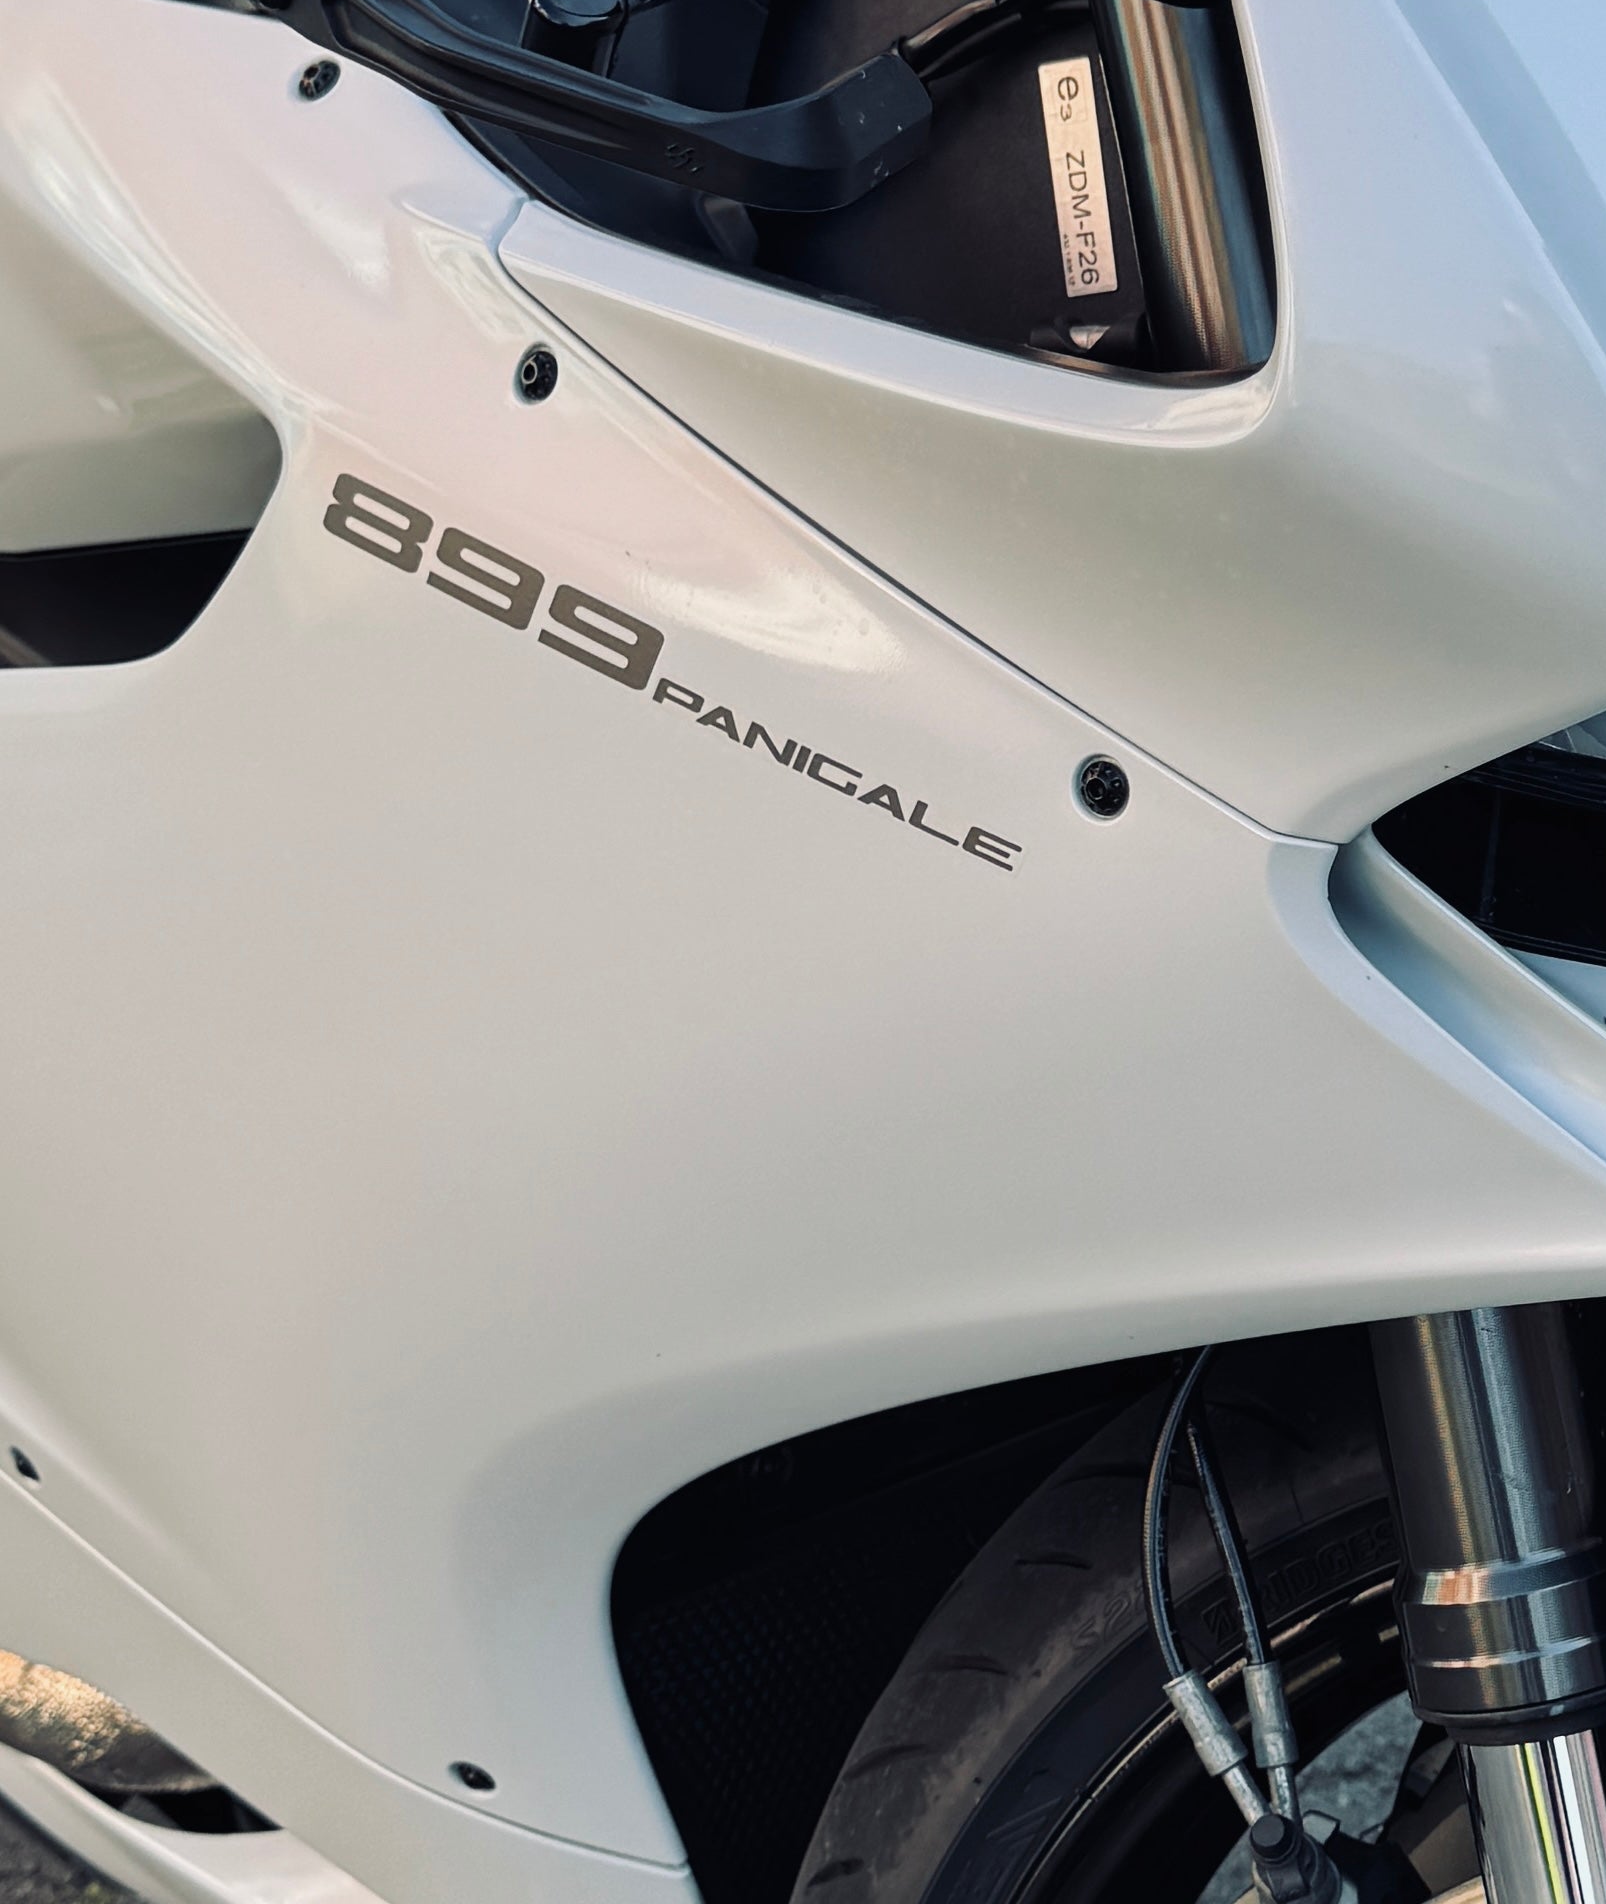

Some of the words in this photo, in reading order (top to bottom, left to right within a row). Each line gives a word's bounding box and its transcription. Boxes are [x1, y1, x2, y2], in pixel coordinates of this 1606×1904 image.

[1066, 149, 1100, 287] ZDM-F26
[322, 472, 666, 692] 899
[651, 676, 1024, 873] PANIGALE
